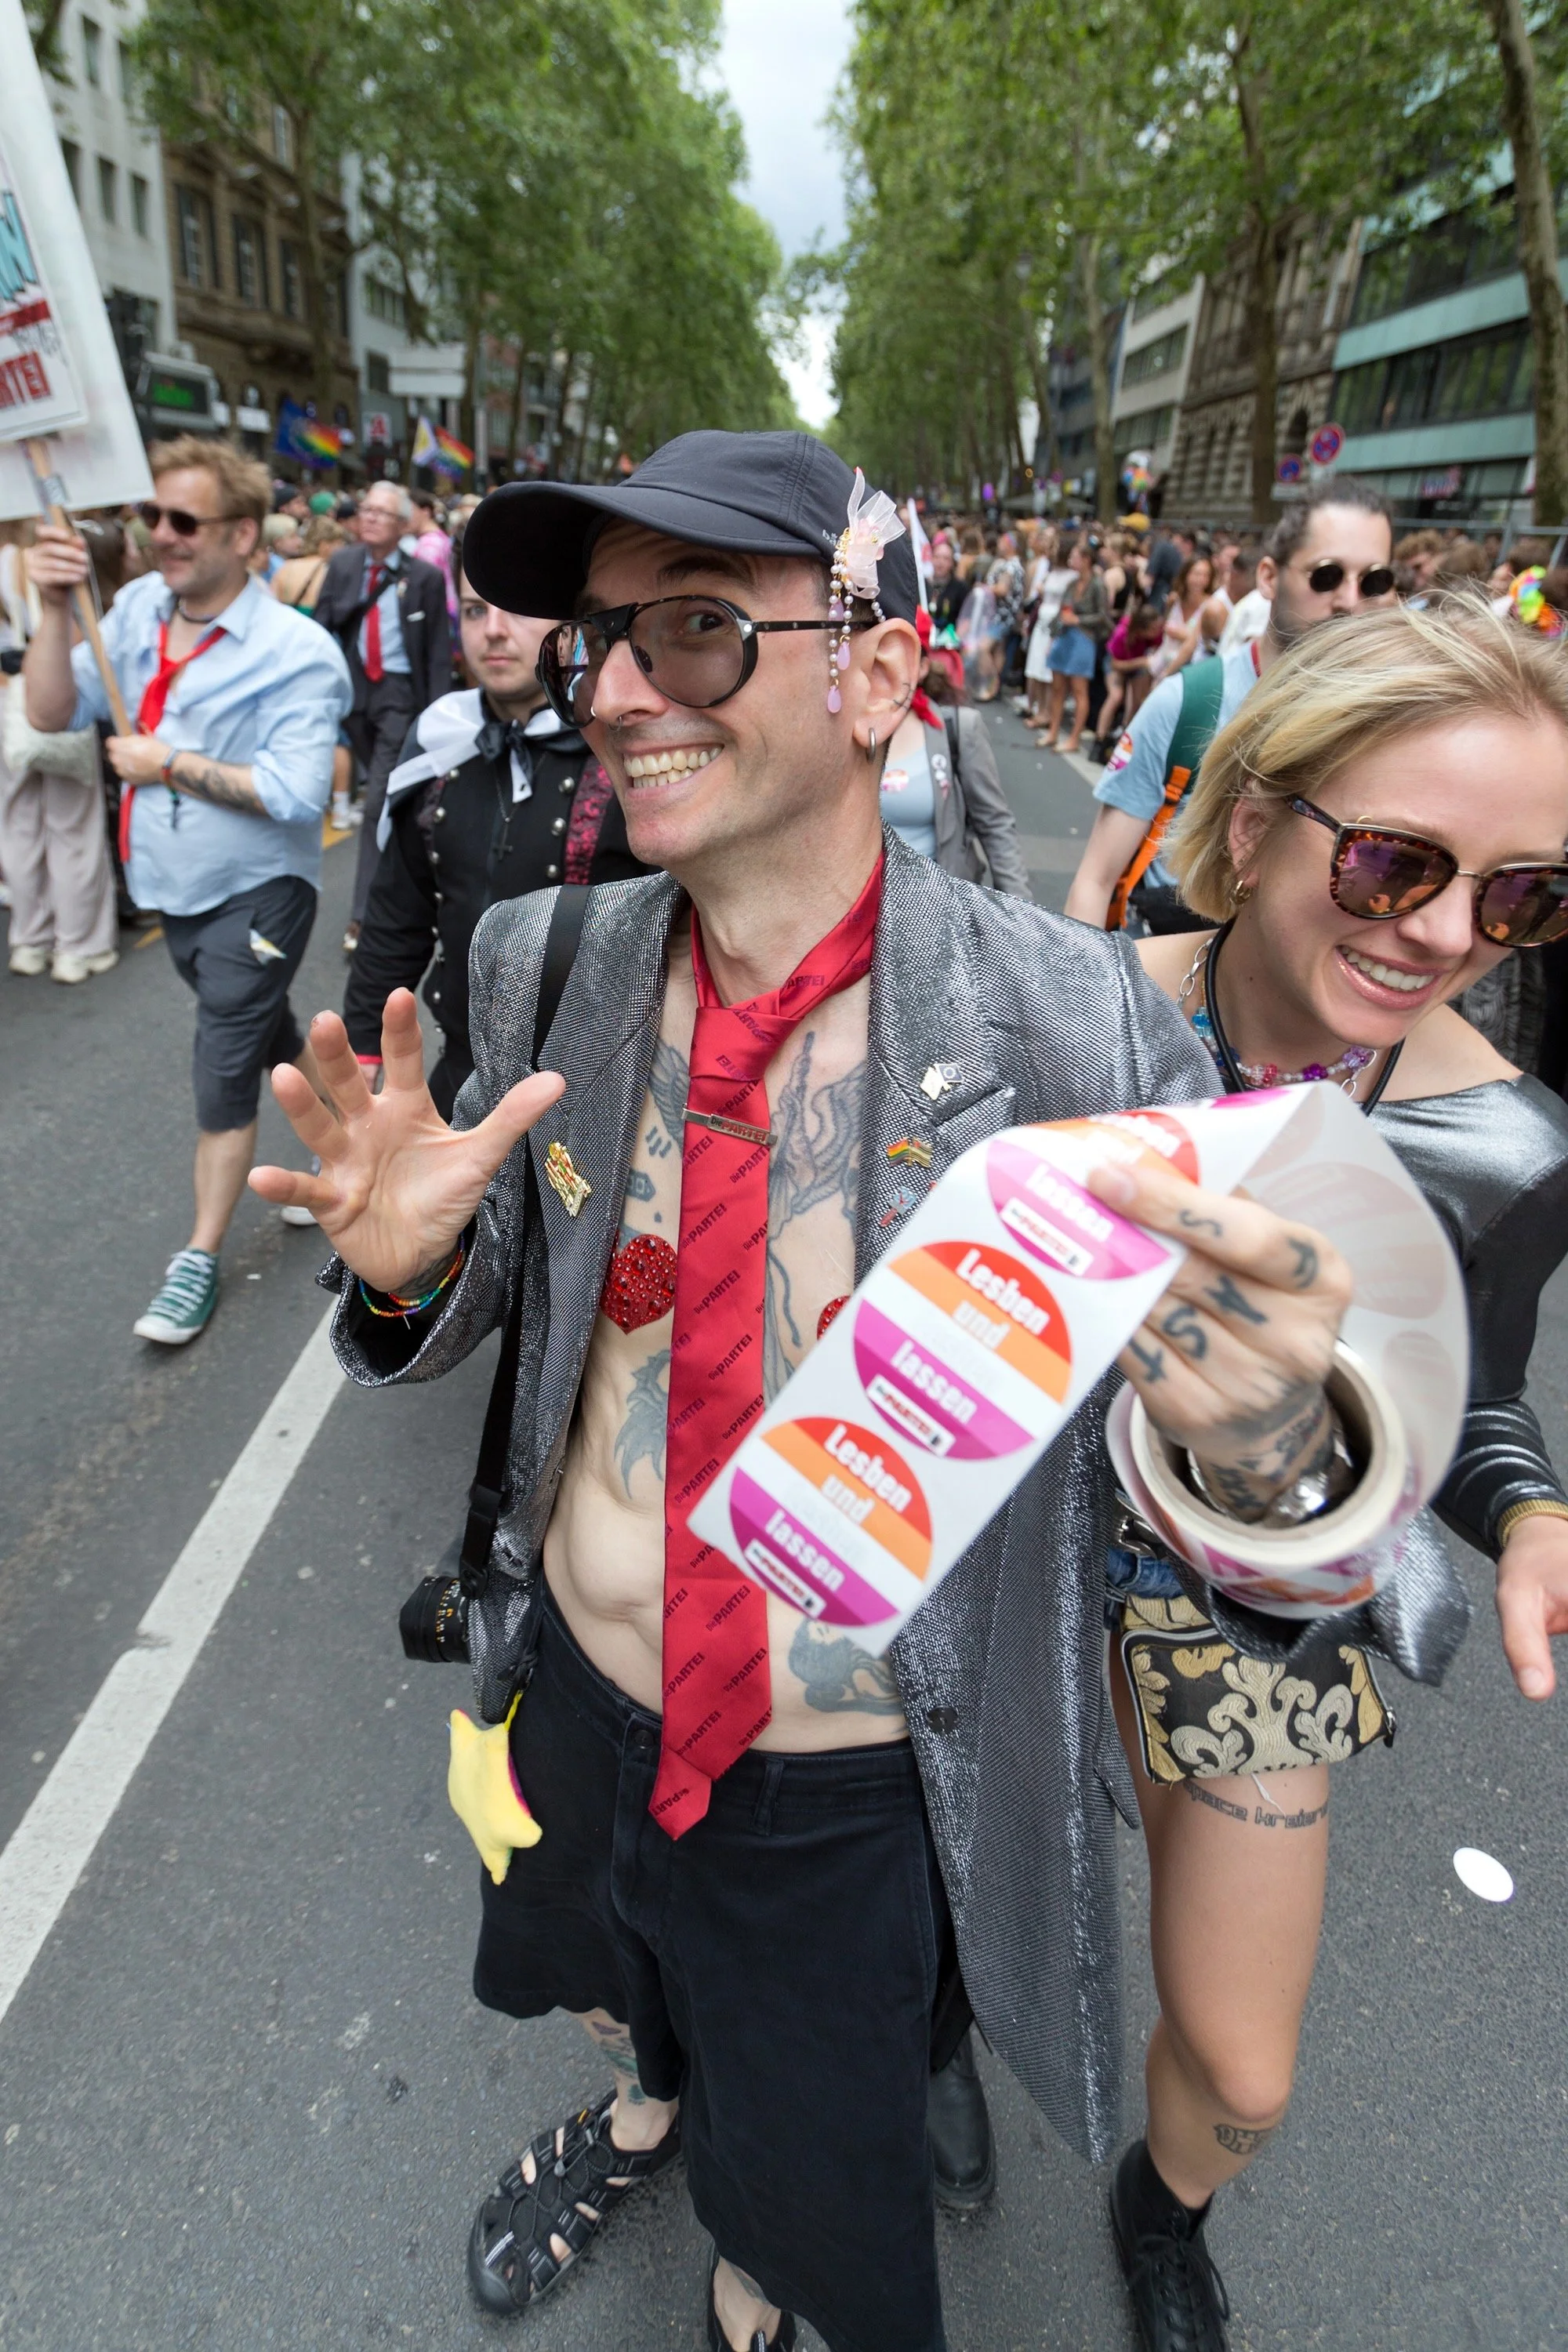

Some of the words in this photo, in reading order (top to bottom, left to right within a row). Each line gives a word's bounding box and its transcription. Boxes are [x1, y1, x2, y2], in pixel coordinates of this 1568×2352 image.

[953, 1300, 1011, 1352] und
[956, 1248, 1051, 1337] Lesben
[891, 1340, 978, 1425] lassen
[822, 1474, 875, 1524] und
[824, 1423, 913, 1513] Lesben
[765, 1508, 846, 1592] lassen
